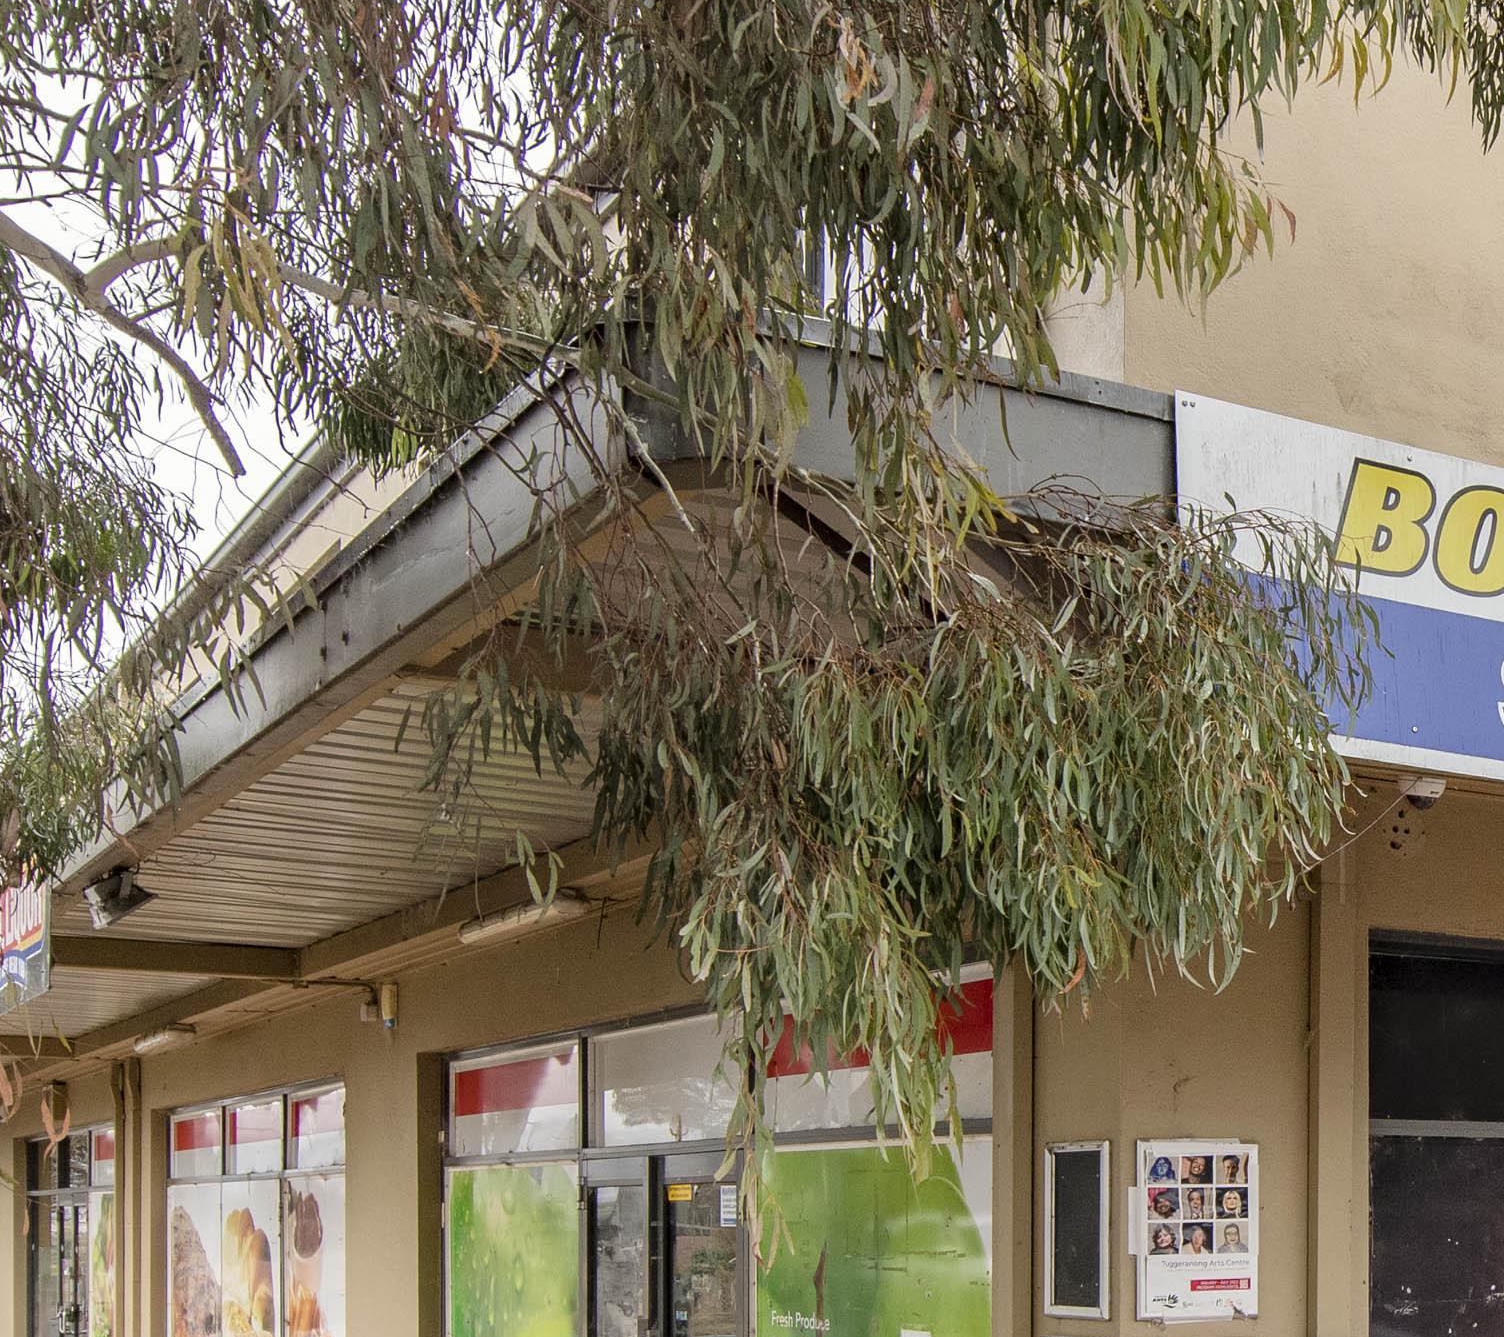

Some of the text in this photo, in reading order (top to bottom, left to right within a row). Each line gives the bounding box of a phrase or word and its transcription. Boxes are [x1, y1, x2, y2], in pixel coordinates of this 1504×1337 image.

[1162, 1260, 1207, 1268] Tuggeranong
[772, 1311, 830, 1330] Fresh Produce
